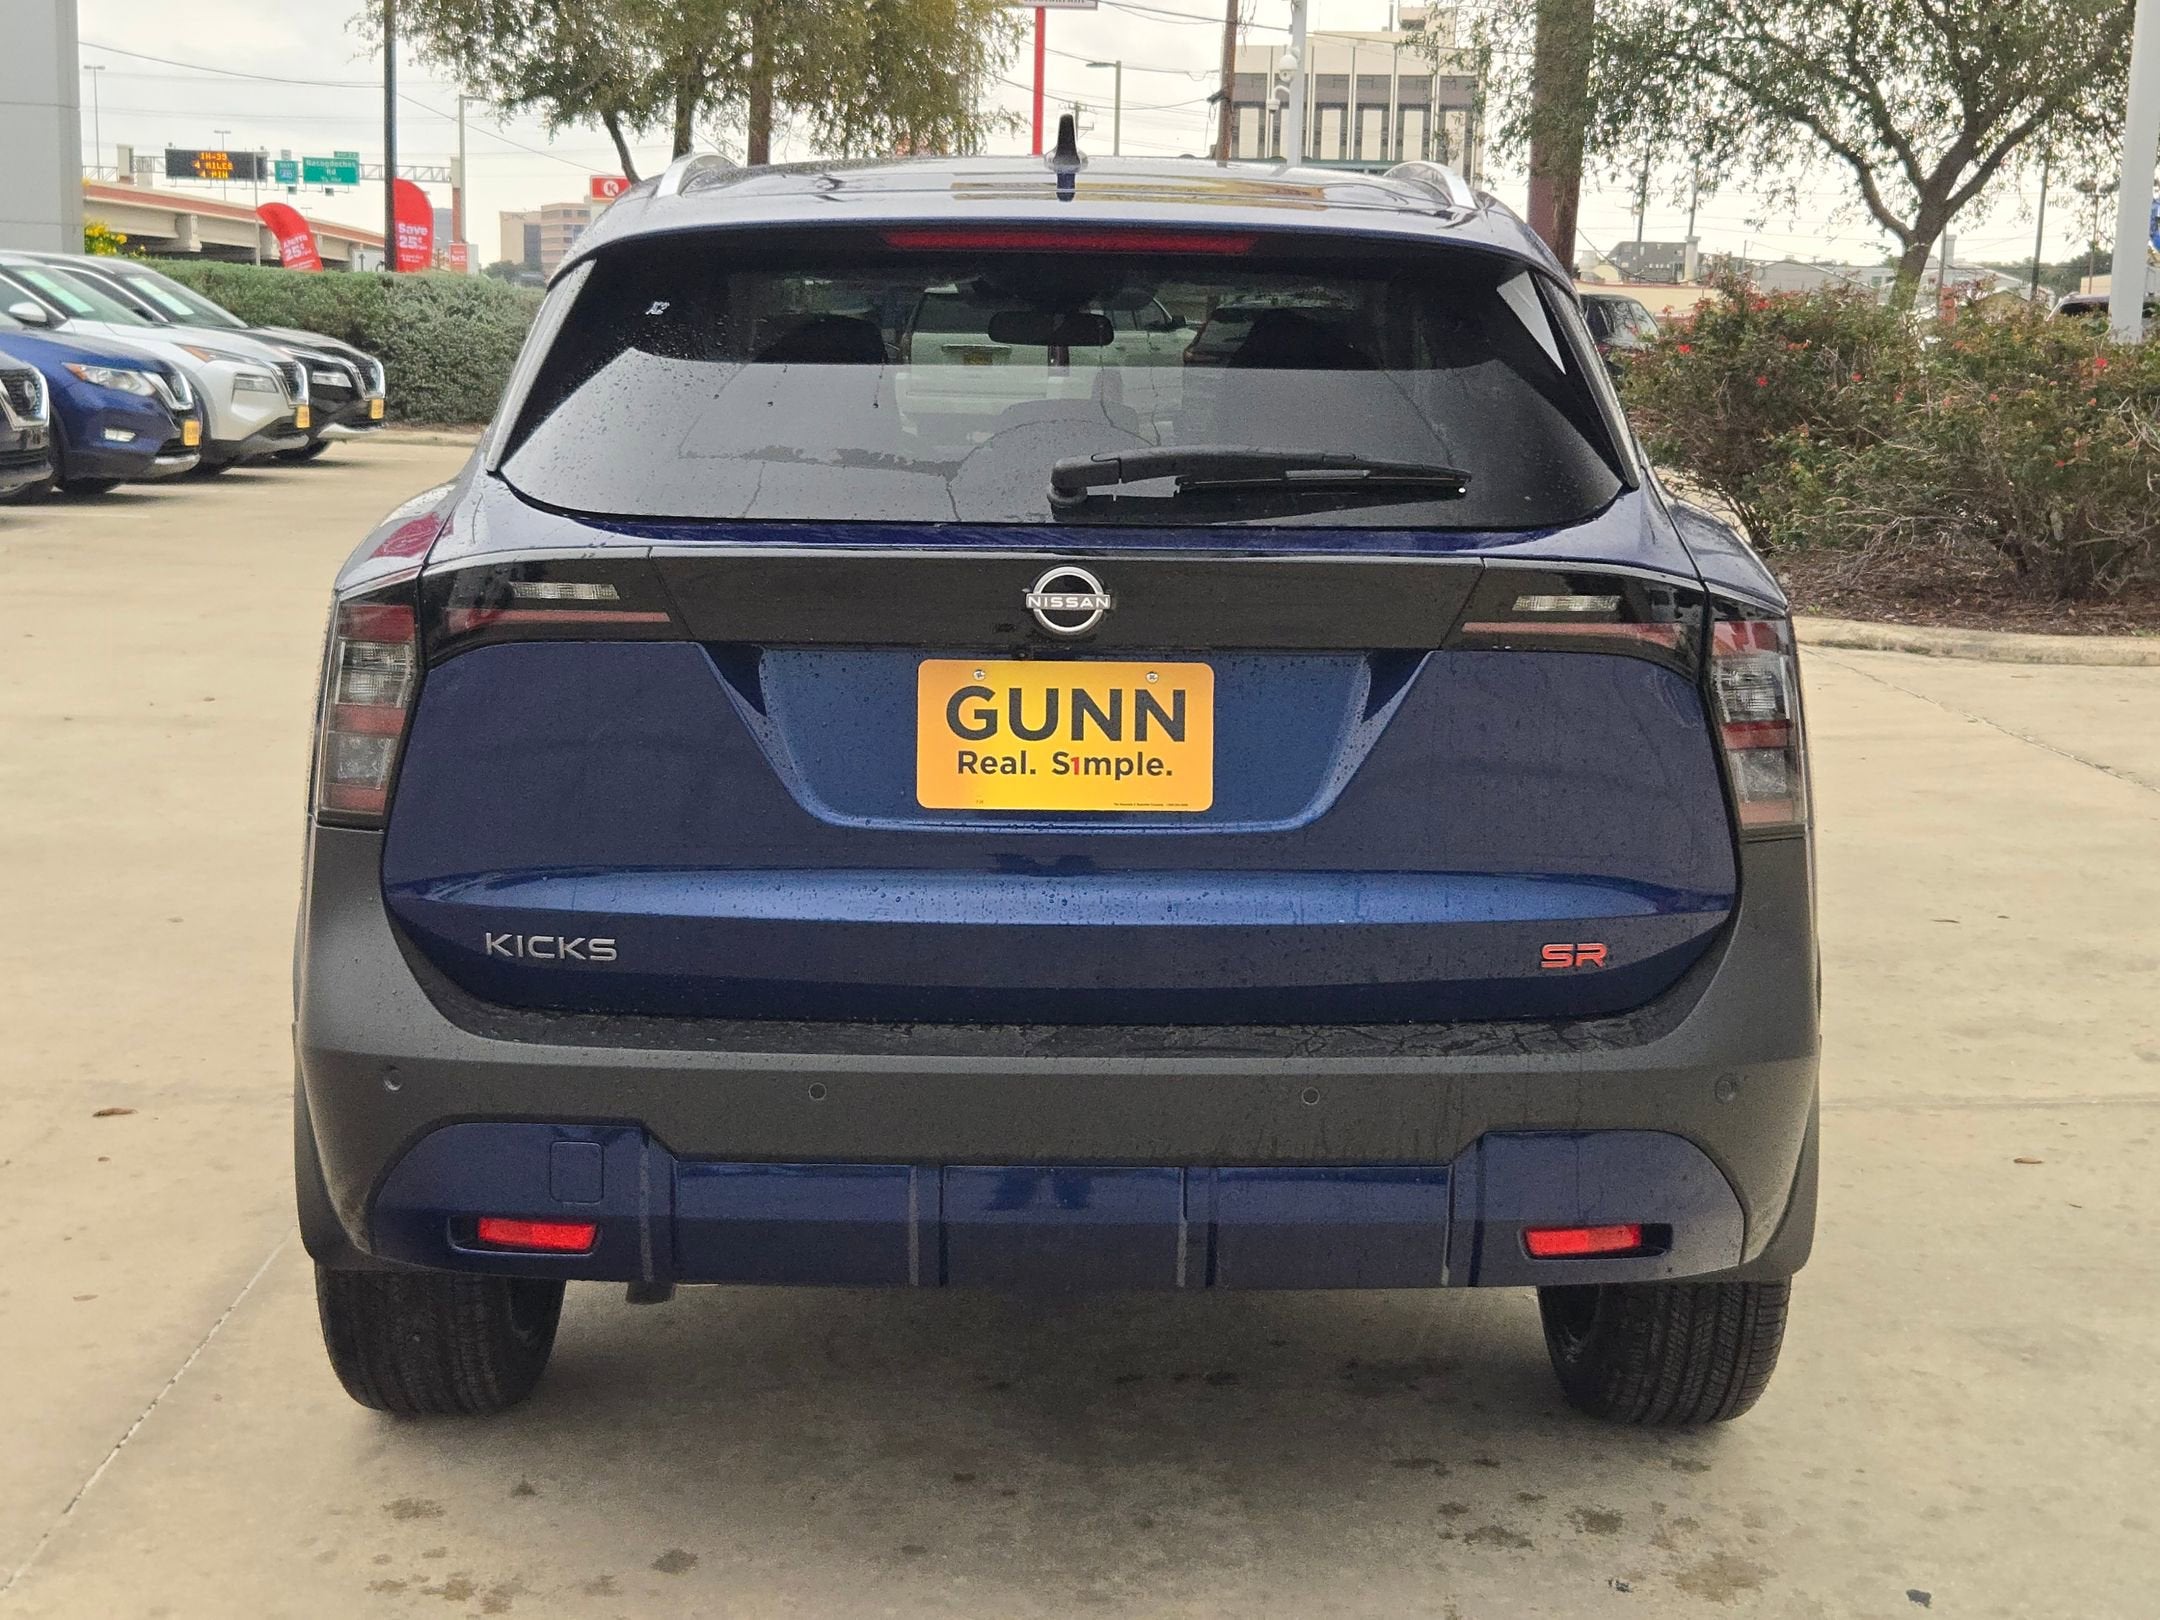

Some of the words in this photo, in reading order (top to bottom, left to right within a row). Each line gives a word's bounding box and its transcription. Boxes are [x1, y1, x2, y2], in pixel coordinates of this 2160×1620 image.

[398, 223, 428, 236] Save
[1027, 595, 1109, 609] NISSAN
[945, 685, 1186, 743] GUNN
[957, 750, 1036, 775] Real.
[485, 932, 618, 962] KICKS
[1541, 943, 1608, 969] SR
